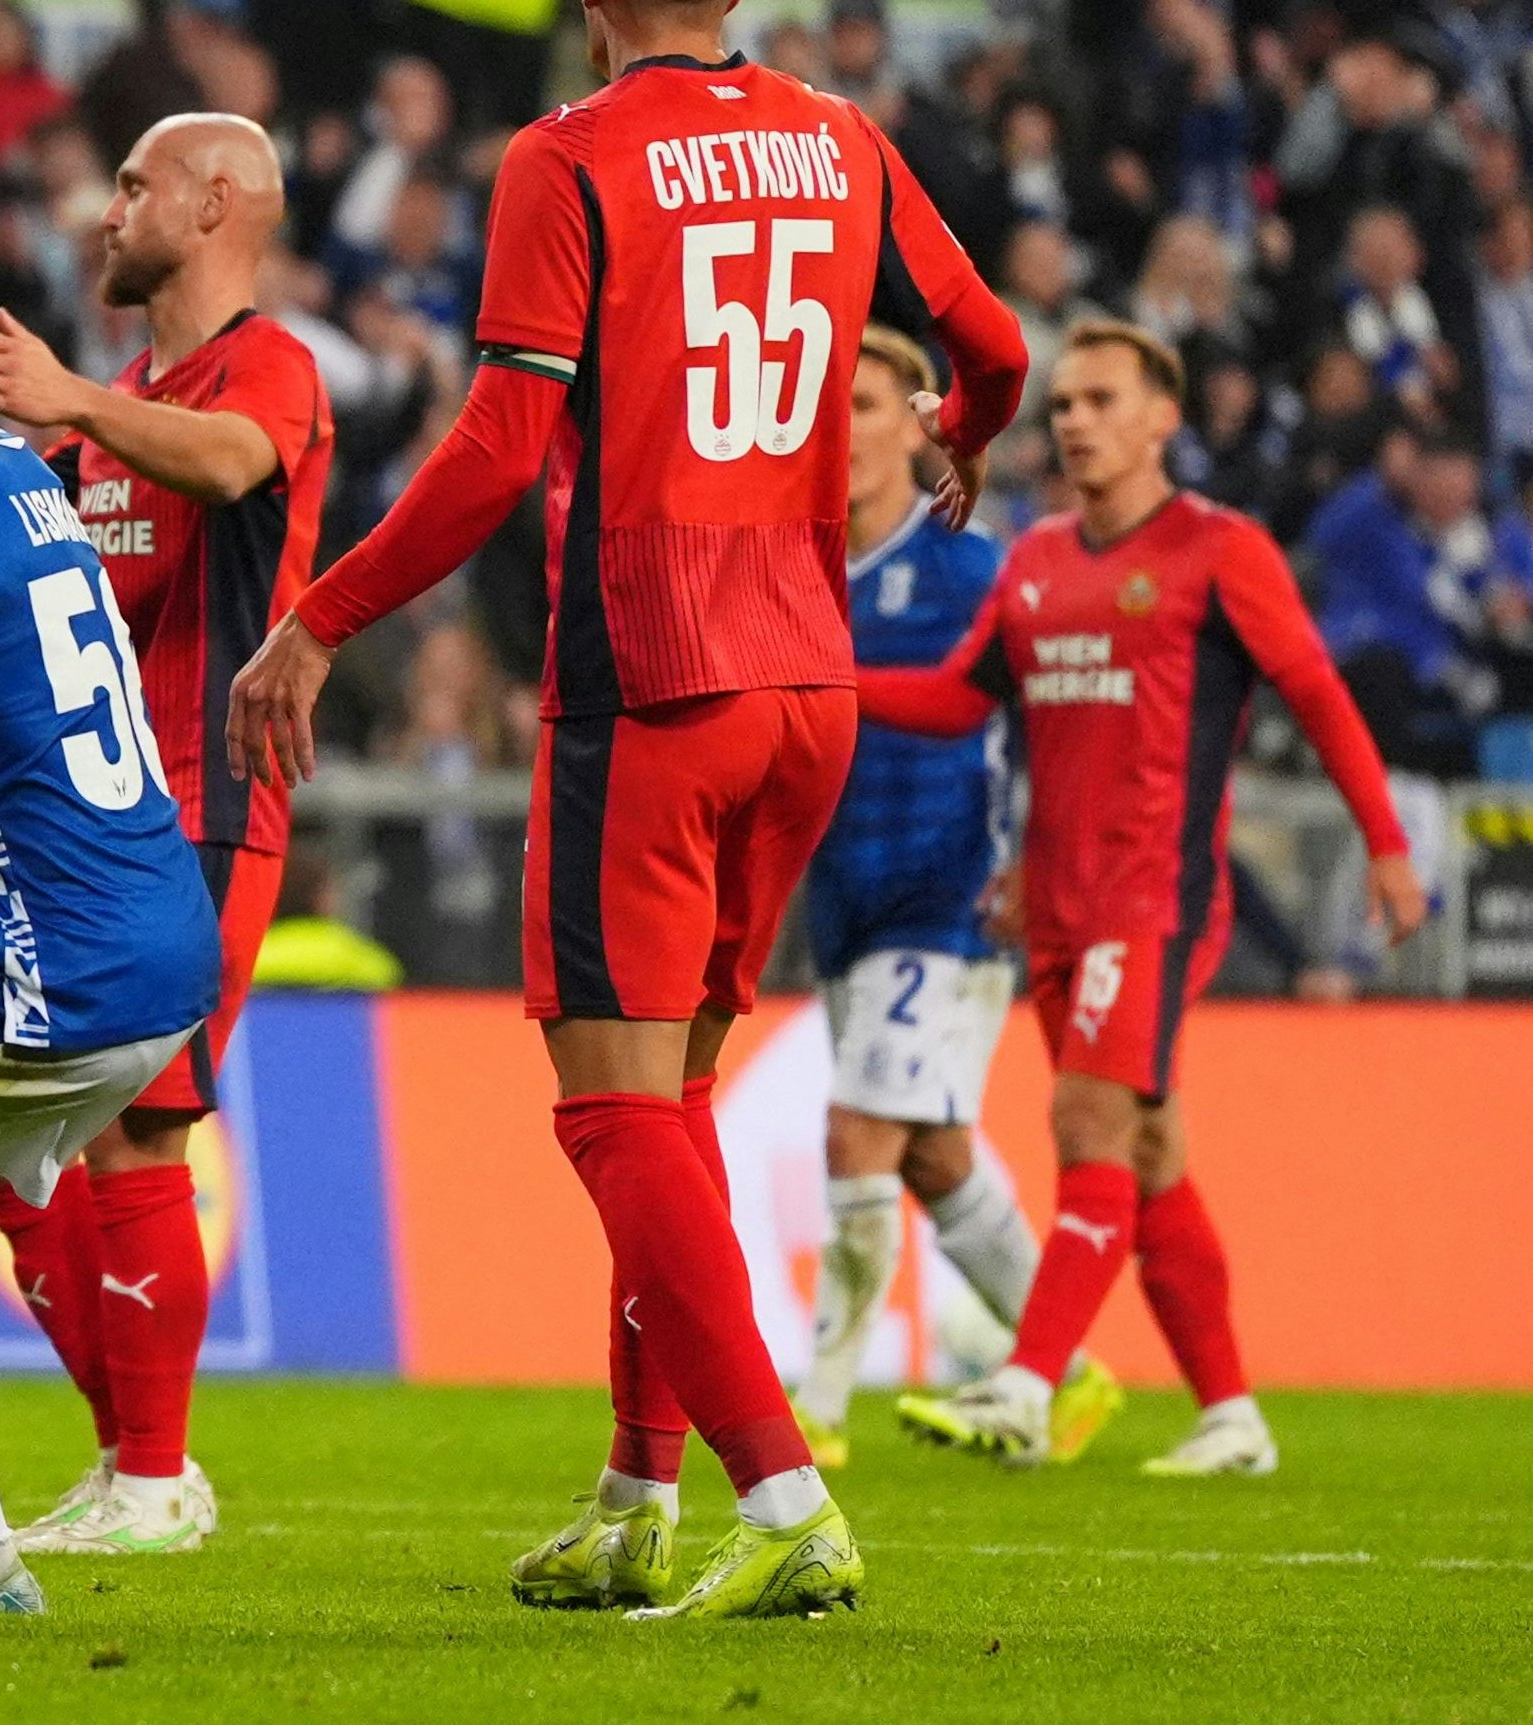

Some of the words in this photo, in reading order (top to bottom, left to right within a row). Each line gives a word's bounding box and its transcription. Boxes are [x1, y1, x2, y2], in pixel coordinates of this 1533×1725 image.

[646, 122, 849, 210] CVETKOVIĆ
[682, 218, 834, 461] 55
[79, 478, 132, 515] WIEN
[85, 519, 154, 555] RGIE
[887, 952, 925, 1026] 2
